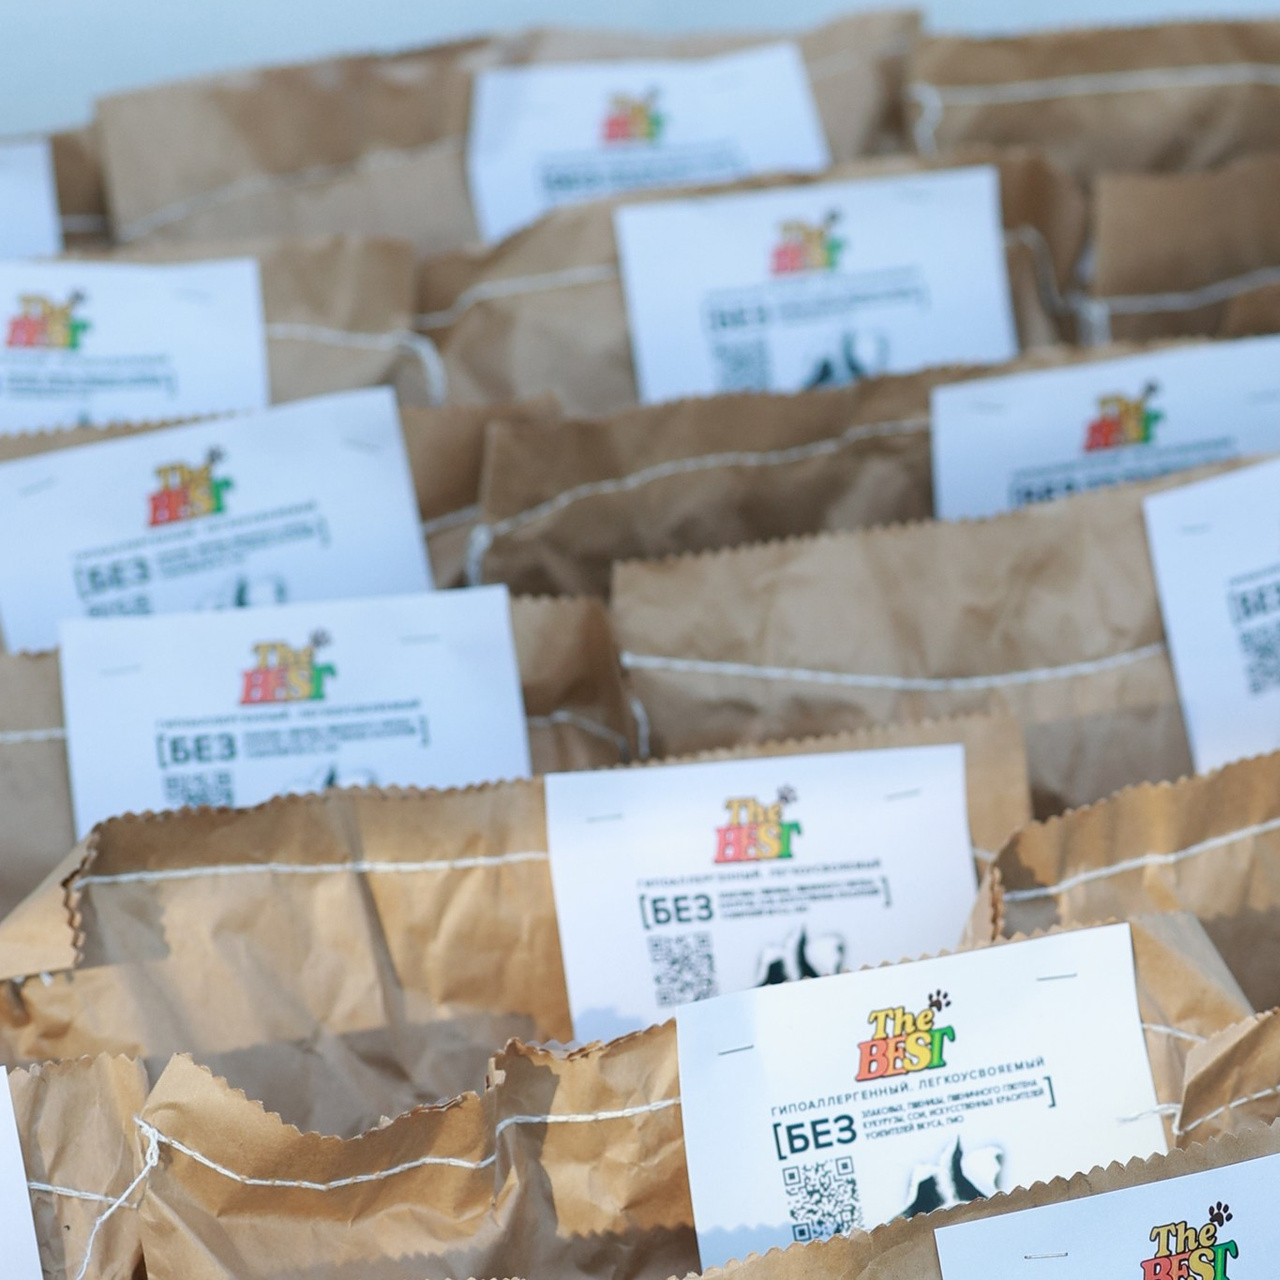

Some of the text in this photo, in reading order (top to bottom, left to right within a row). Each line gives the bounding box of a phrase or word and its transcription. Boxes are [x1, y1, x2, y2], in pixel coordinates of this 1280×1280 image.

[868, 1005, 935, 1042] The
[854, 1024, 956, 1082] BEST
[918, 1056, 1045, 1089] ЛЕГКОУСВОЯЕМЫЙ
[1149, 1220, 1217, 1259] The
